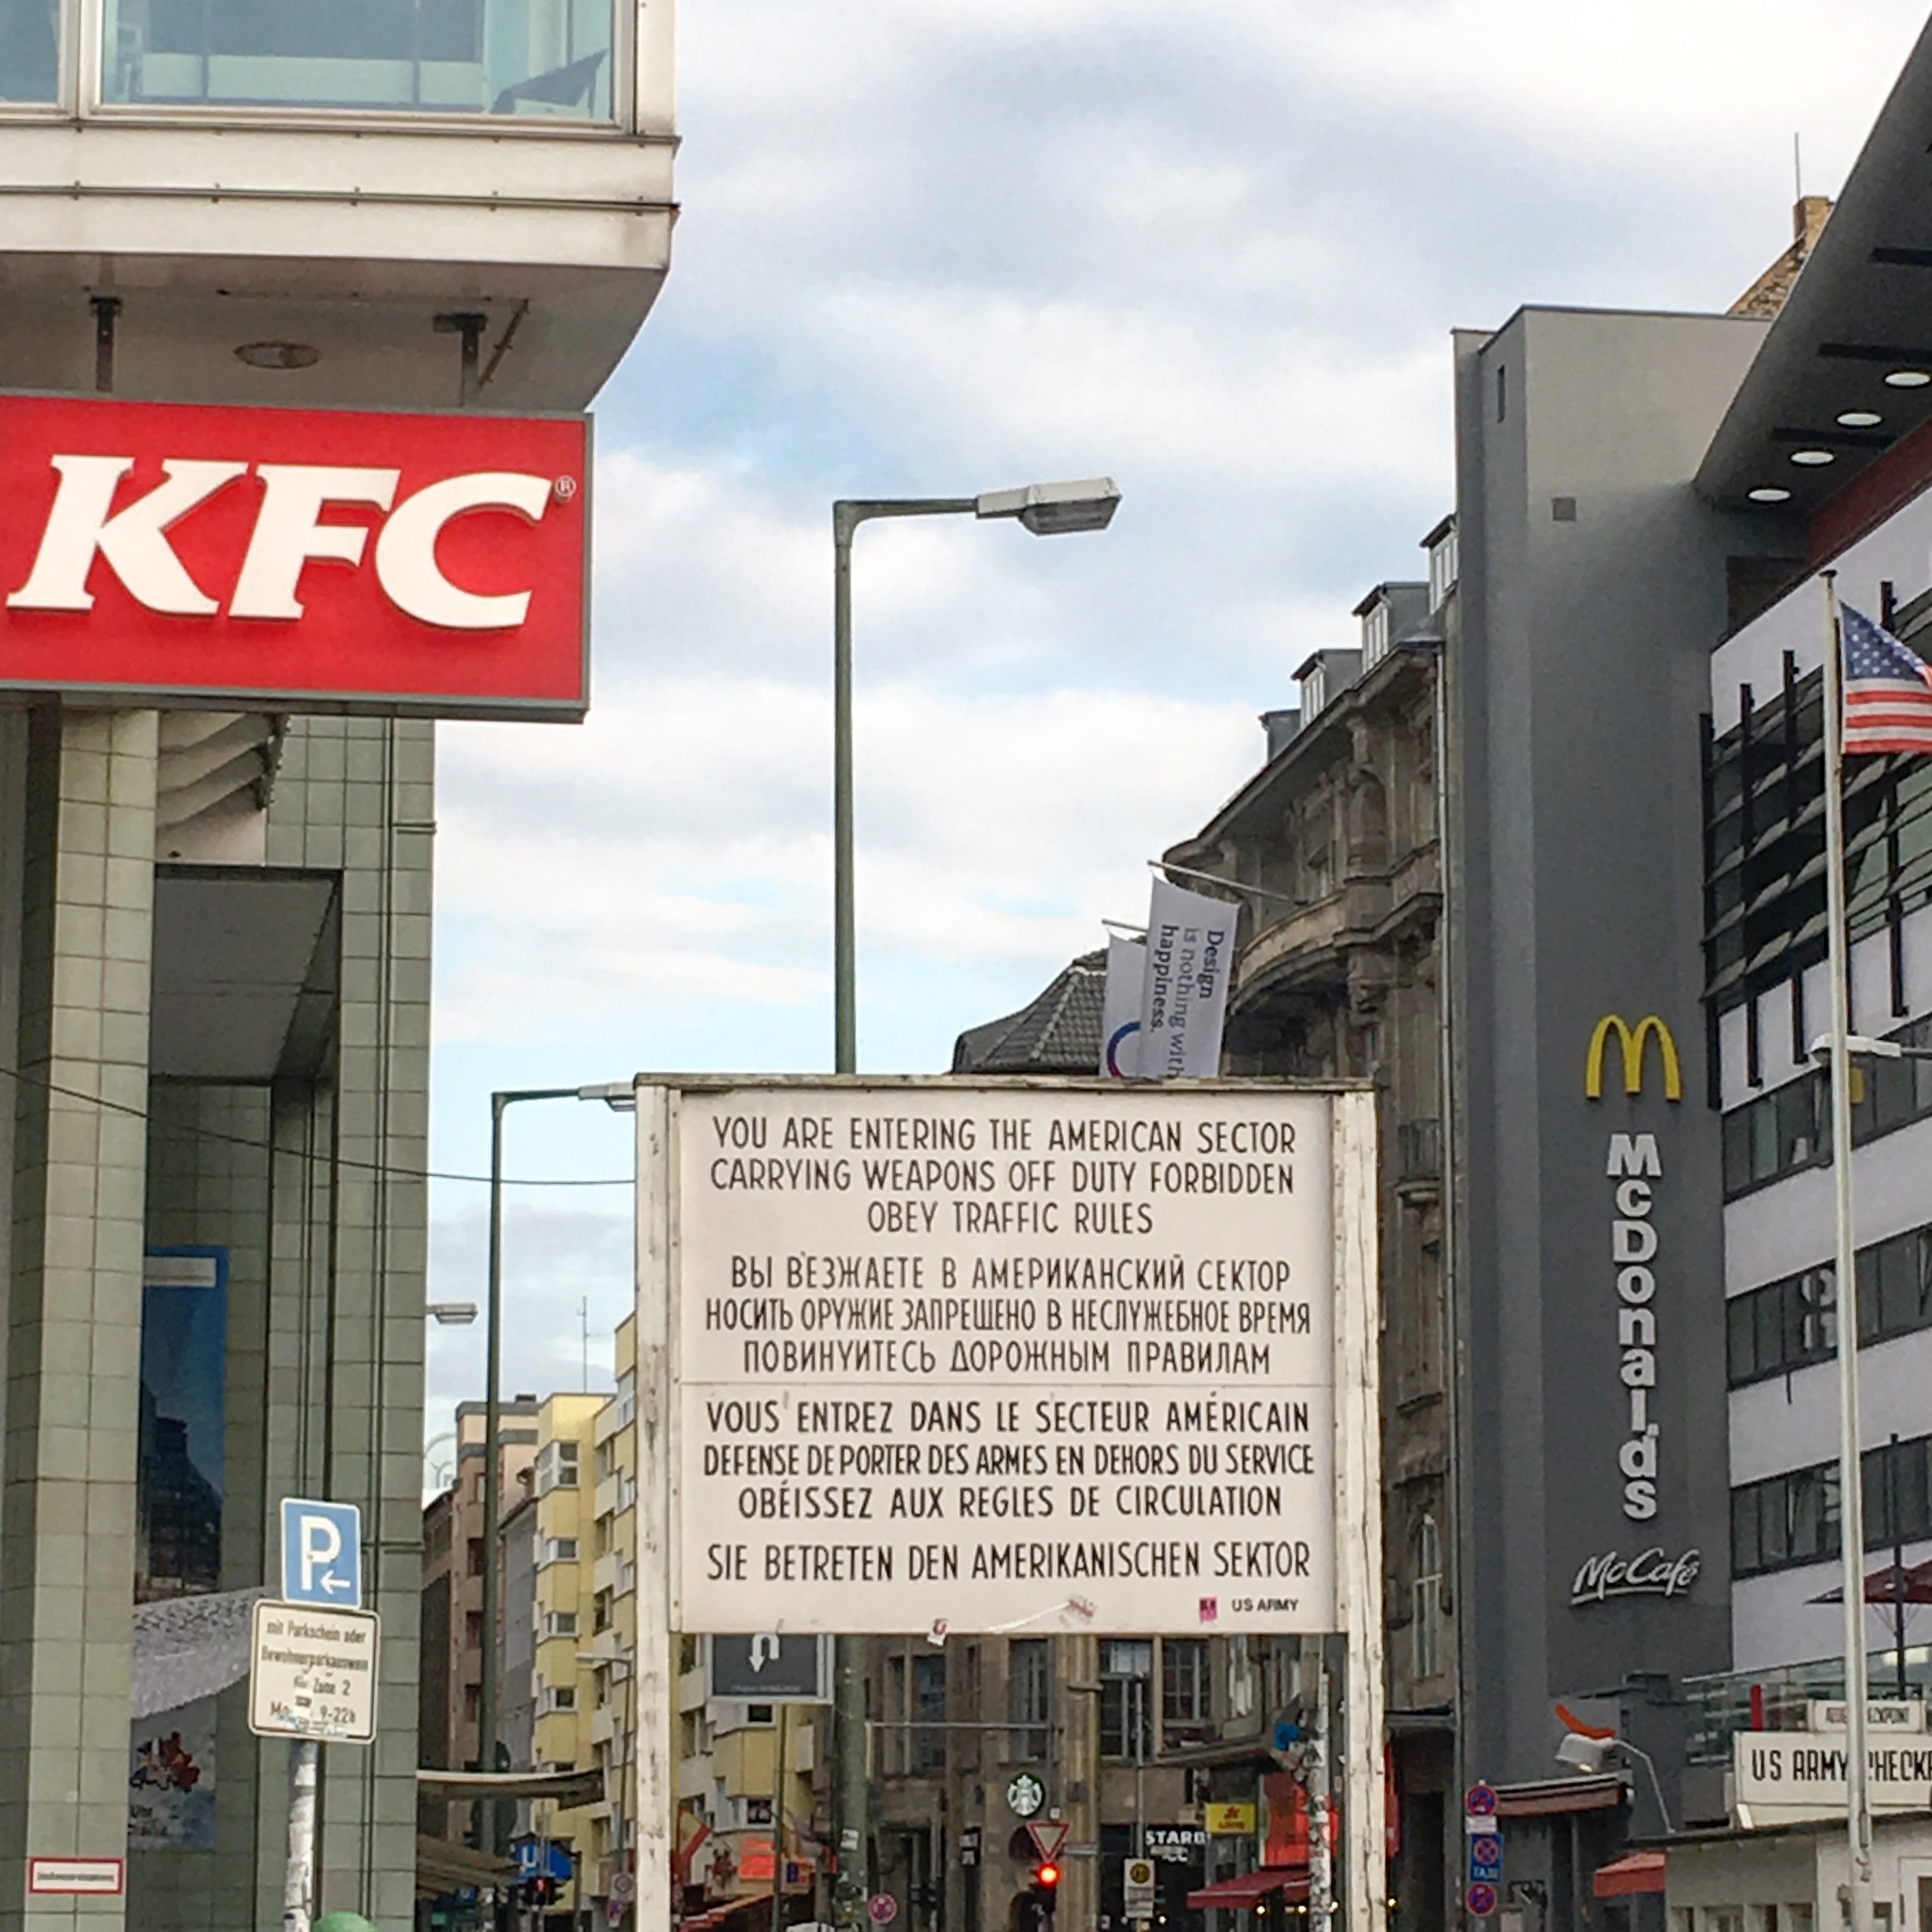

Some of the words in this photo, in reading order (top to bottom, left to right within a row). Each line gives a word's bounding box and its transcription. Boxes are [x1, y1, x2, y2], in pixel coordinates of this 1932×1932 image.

[5, 453, 552, 630] KFC
[1149, 924, 1179, 1033] happiness.
[1196, 930, 1225, 999] Design
[1168, 949, 1196, 1029] nothing
[712, 1116, 767, 1149] YOU
[782, 1117, 833, 1149] ARE
[850, 1117, 976, 1151] ENTERING
[989, 1118, 1032, 1151] THE
[1047, 1119, 1181, 1153] AMERICAN
[1196, 1121, 1296, 1155] SECTOR
[710, 1157, 851, 1191] CARRYING
[862, 1159, 996, 1193] WEAPONS
[1008, 1159, 1056, 1192] OFF
[1072, 1160, 1137, 1193] DUTY
[1150, 1161, 1293, 1194] FORBIDDEN
[867, 1200, 939, 1233] OBEY
[952, 1200, 1059, 1234] TRAFFIC
[1075, 1201, 1153, 1235] RULES
[732, 1255, 773, 1289] ВЫ
[941, 1257, 956, 1289] В
[971, 1253, 1185, 1291] АМЕРИКАНСКИЙ
[1197, 1259, 1290, 1292] СЕКТОР
[706, 1298, 794, 1331] НОСИТЬ
[800, 1298, 894, 1331] ОРУЖИЕ
[1047, 1298, 1062, 1331] В
[1071, 1298, 1230, 1333] НЕСЛУЖЕБНОЕ
[1239, 1300, 1311, 1334] ВРЕМЯ
[950, 1340, 1110, 1373] ДОРОЖНЫМ
[1127, 1341, 1270, 1375] ПРАВИЛАМ
[706, 1399, 780, 1434] VOUS
[797, 1401, 894, 1434] ENTREZ
[910, 1400, 982, 1434] DANS
[996, 1401, 1019, 1433] LE
[1035, 1400, 1150, 1434] SECTEUR
[1166, 1391, 1309, 1433] AMÉRICAIN
[703, 1444, 799, 1477] DEFENSE
[807, 1444, 835, 1477] DE
[840, 1443, 922, 1476] PORTER
[928, 1443, 969, 1476] DES
[975, 1444, 1048, 1476] ARMES
[1056, 1445, 1084, 1476] EN
[1094, 1443, 1179, 1476] DEHORS
[1188, 1444, 1218, 1475] DU
[1224, 1443, 1315, 1475] SERVICE
[738, 1479, 873, 1520] OBÉISSEZ
[889, 1486, 944, 1519] AUX
[959, 1485, 1054, 1518] REGLES
[1070, 1486, 1100, 1517] DE
[1116, 1484, 1281, 1517] CIRCULATION
[300, 1515, 341, 1591] P
[707, 1543, 747, 1581] SIE
[764, 1544, 893, 1582] BETRETEN
[909, 1544, 958, 1581] DEN
[971, 1541, 1200, 1580] AMERIKANISCHEN
[1213, 1540, 1310, 1578] SEKTOR
[1572, 1547, 1700, 1601] McCafé
[1231, 1598, 1254, 1612] US
[1257, 1598, 1300, 1612] ARMY
[288, 1620, 340, 1641] Parkschein
[345, 1629, 366, 1643] oder
[342, 1679, 351, 1696] 2
[1752, 1749, 1782, 1782] US
[1793, 1749, 1848, 1782] ARMY
